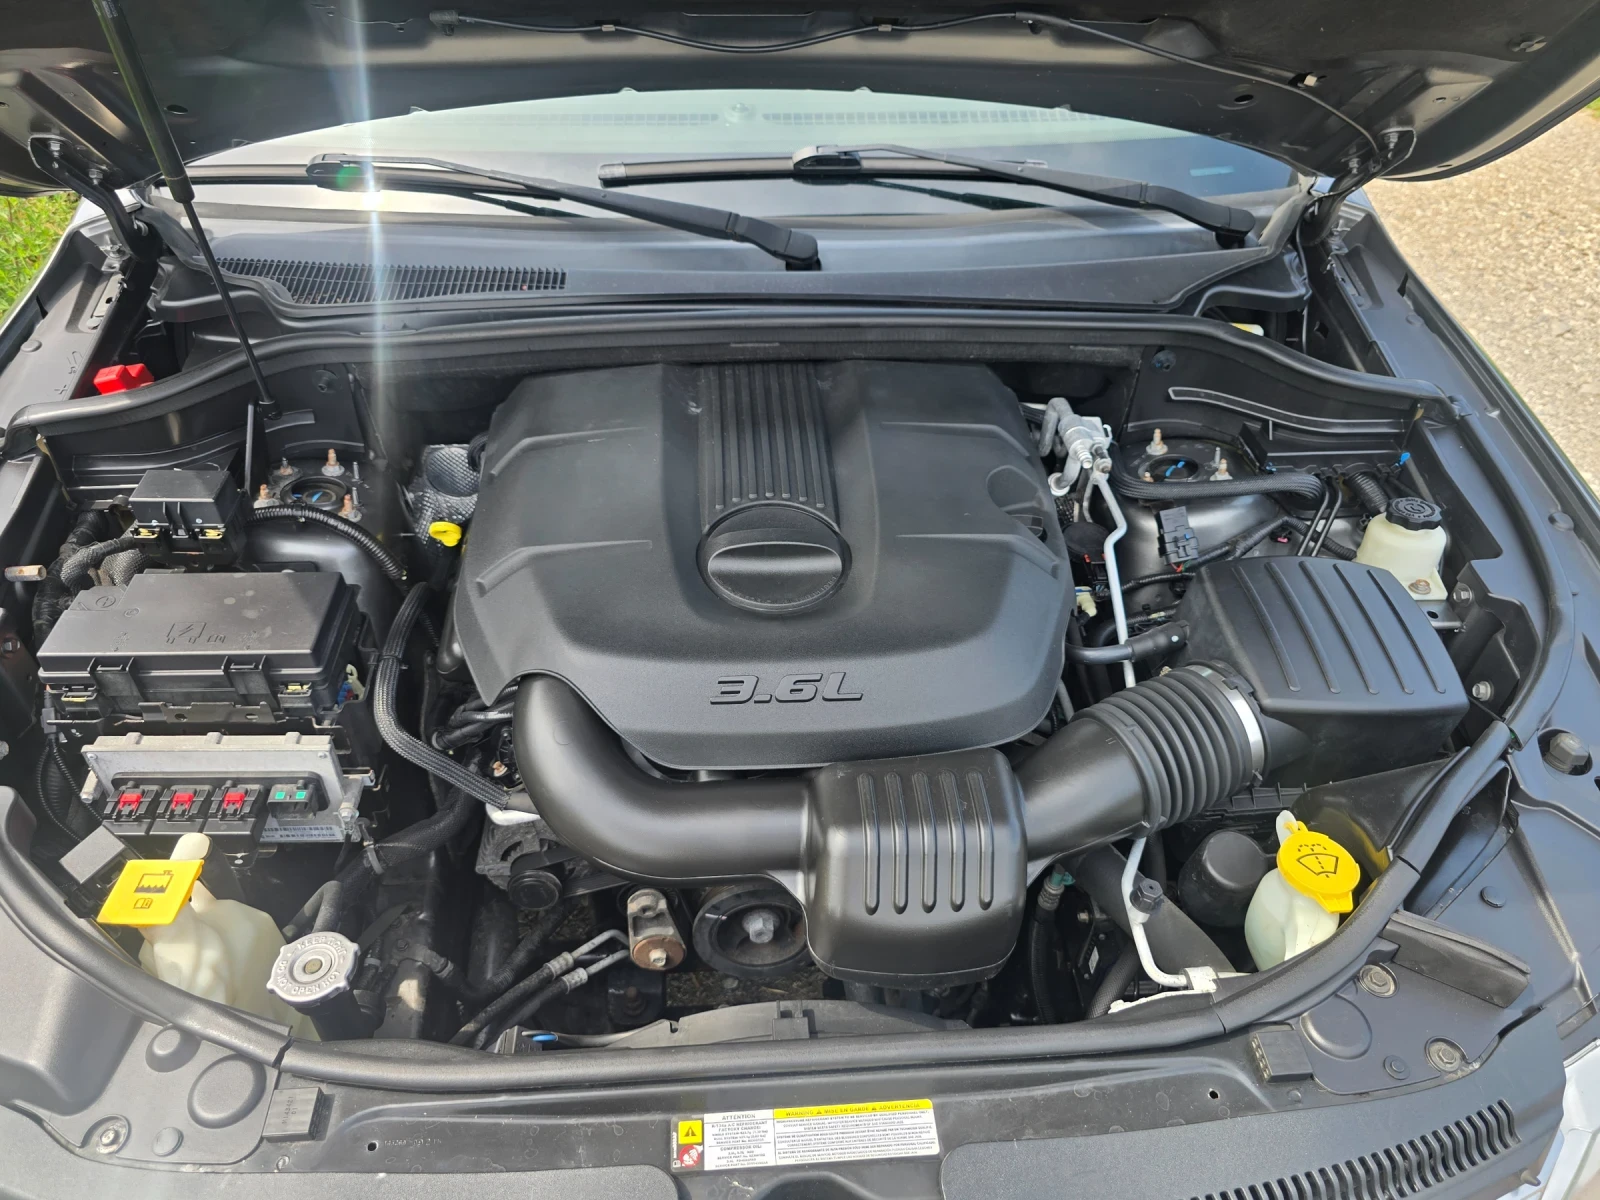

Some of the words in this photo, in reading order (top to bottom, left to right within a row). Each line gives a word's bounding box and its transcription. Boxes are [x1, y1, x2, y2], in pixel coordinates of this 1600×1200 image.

[710, 672, 864, 705] 3.6L
[296, 936, 327, 950] KEEP
[278, 960, 288, 972] DO
[277, 975, 293, 990] NOT
[322, 970, 340, 987] HOT
[292, 984, 320, 995] OPEN
